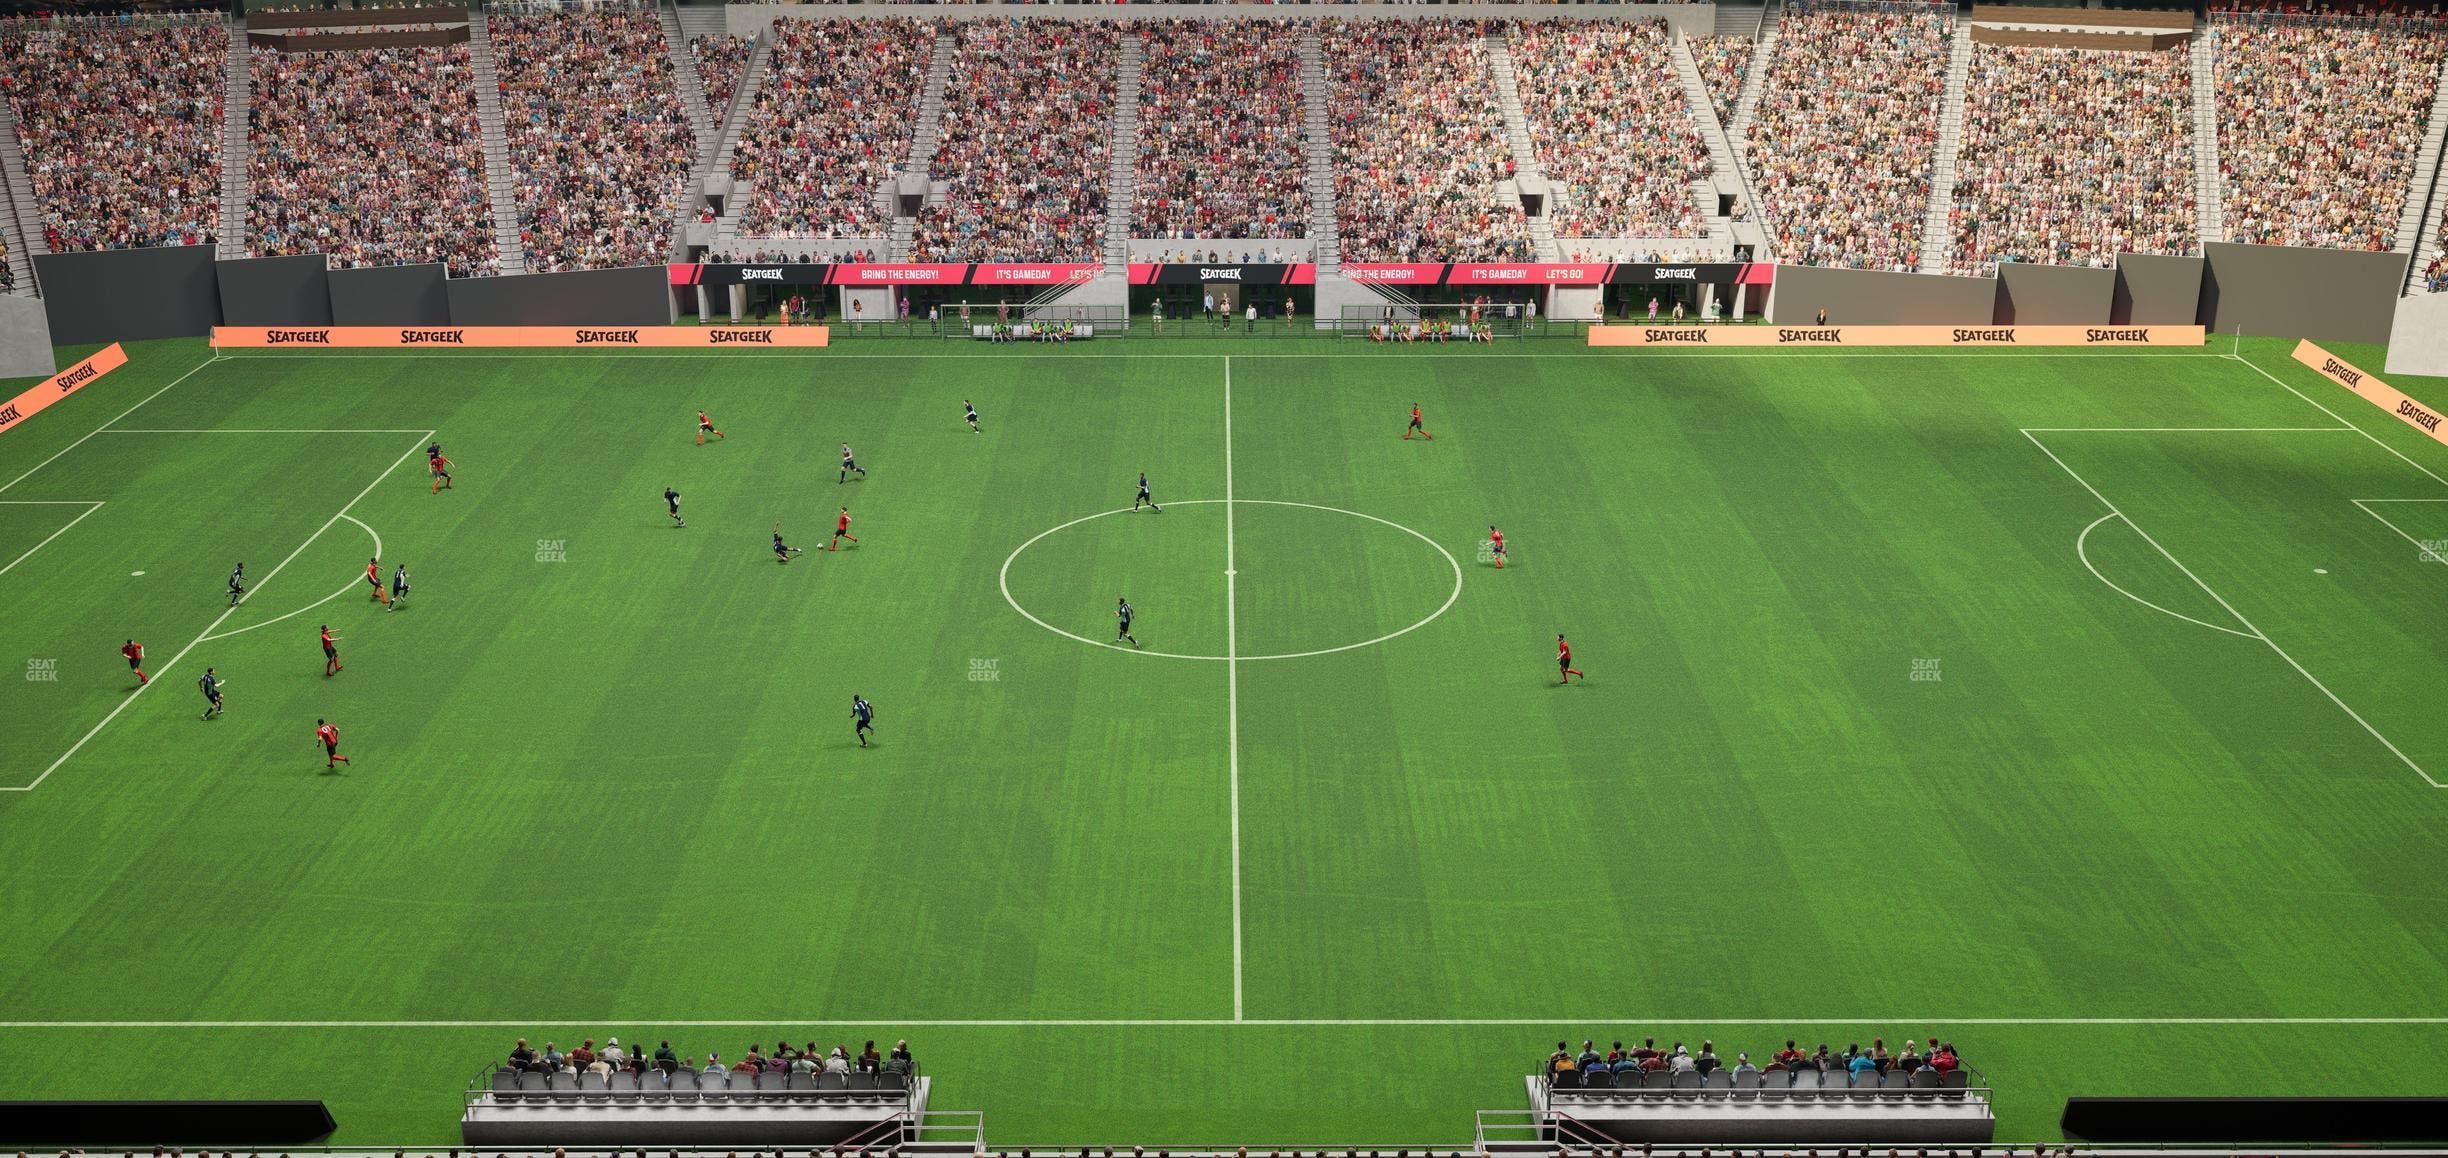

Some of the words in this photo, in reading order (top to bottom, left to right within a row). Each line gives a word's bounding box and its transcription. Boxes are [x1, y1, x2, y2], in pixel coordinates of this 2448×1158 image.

[742, 268, 783, 280] SEATGEEK
[861, 269, 887, 279] BRING
[888, 269, 903, 279] THE
[904, 269, 939, 279] ENERGY!
[996, 269, 1011, 279] IT'S
[1013, 269, 1051, 279] GAMEDAY
[1200, 268, 1242, 280] SEATGEEK
[1380, 269, 1415, 279] ENERGY!
[1472, 269, 1487, 279] IT'S
[1488, 269, 1528, 279] GAMEDAY
[1545, 269, 1568, 279] LET'S
[1569, 269, 1584, 279] GO!
[1655, 268, 1696, 280] SEATGEEK
[267, 330, 330, 344] SEATGEEK
[401, 330, 464, 344] SEATGEEK
[576, 330, 638, 344] SEATGEEK
[710, 330, 772, 344] SEATGEEK
[1645, 329, 1708, 343] SEATGEEK
[1779, 329, 1841, 343] SEATGEEK
[1953, 329, 2015, 343] SEATGEEK
[2087, 329, 2149, 343] SEATGEEK
[57, 361, 98, 392] SEATGEEK
[2323, 358, 2363, 388] SEATGEEK
[2396, 400, 2442, 433] SEATGEEK
